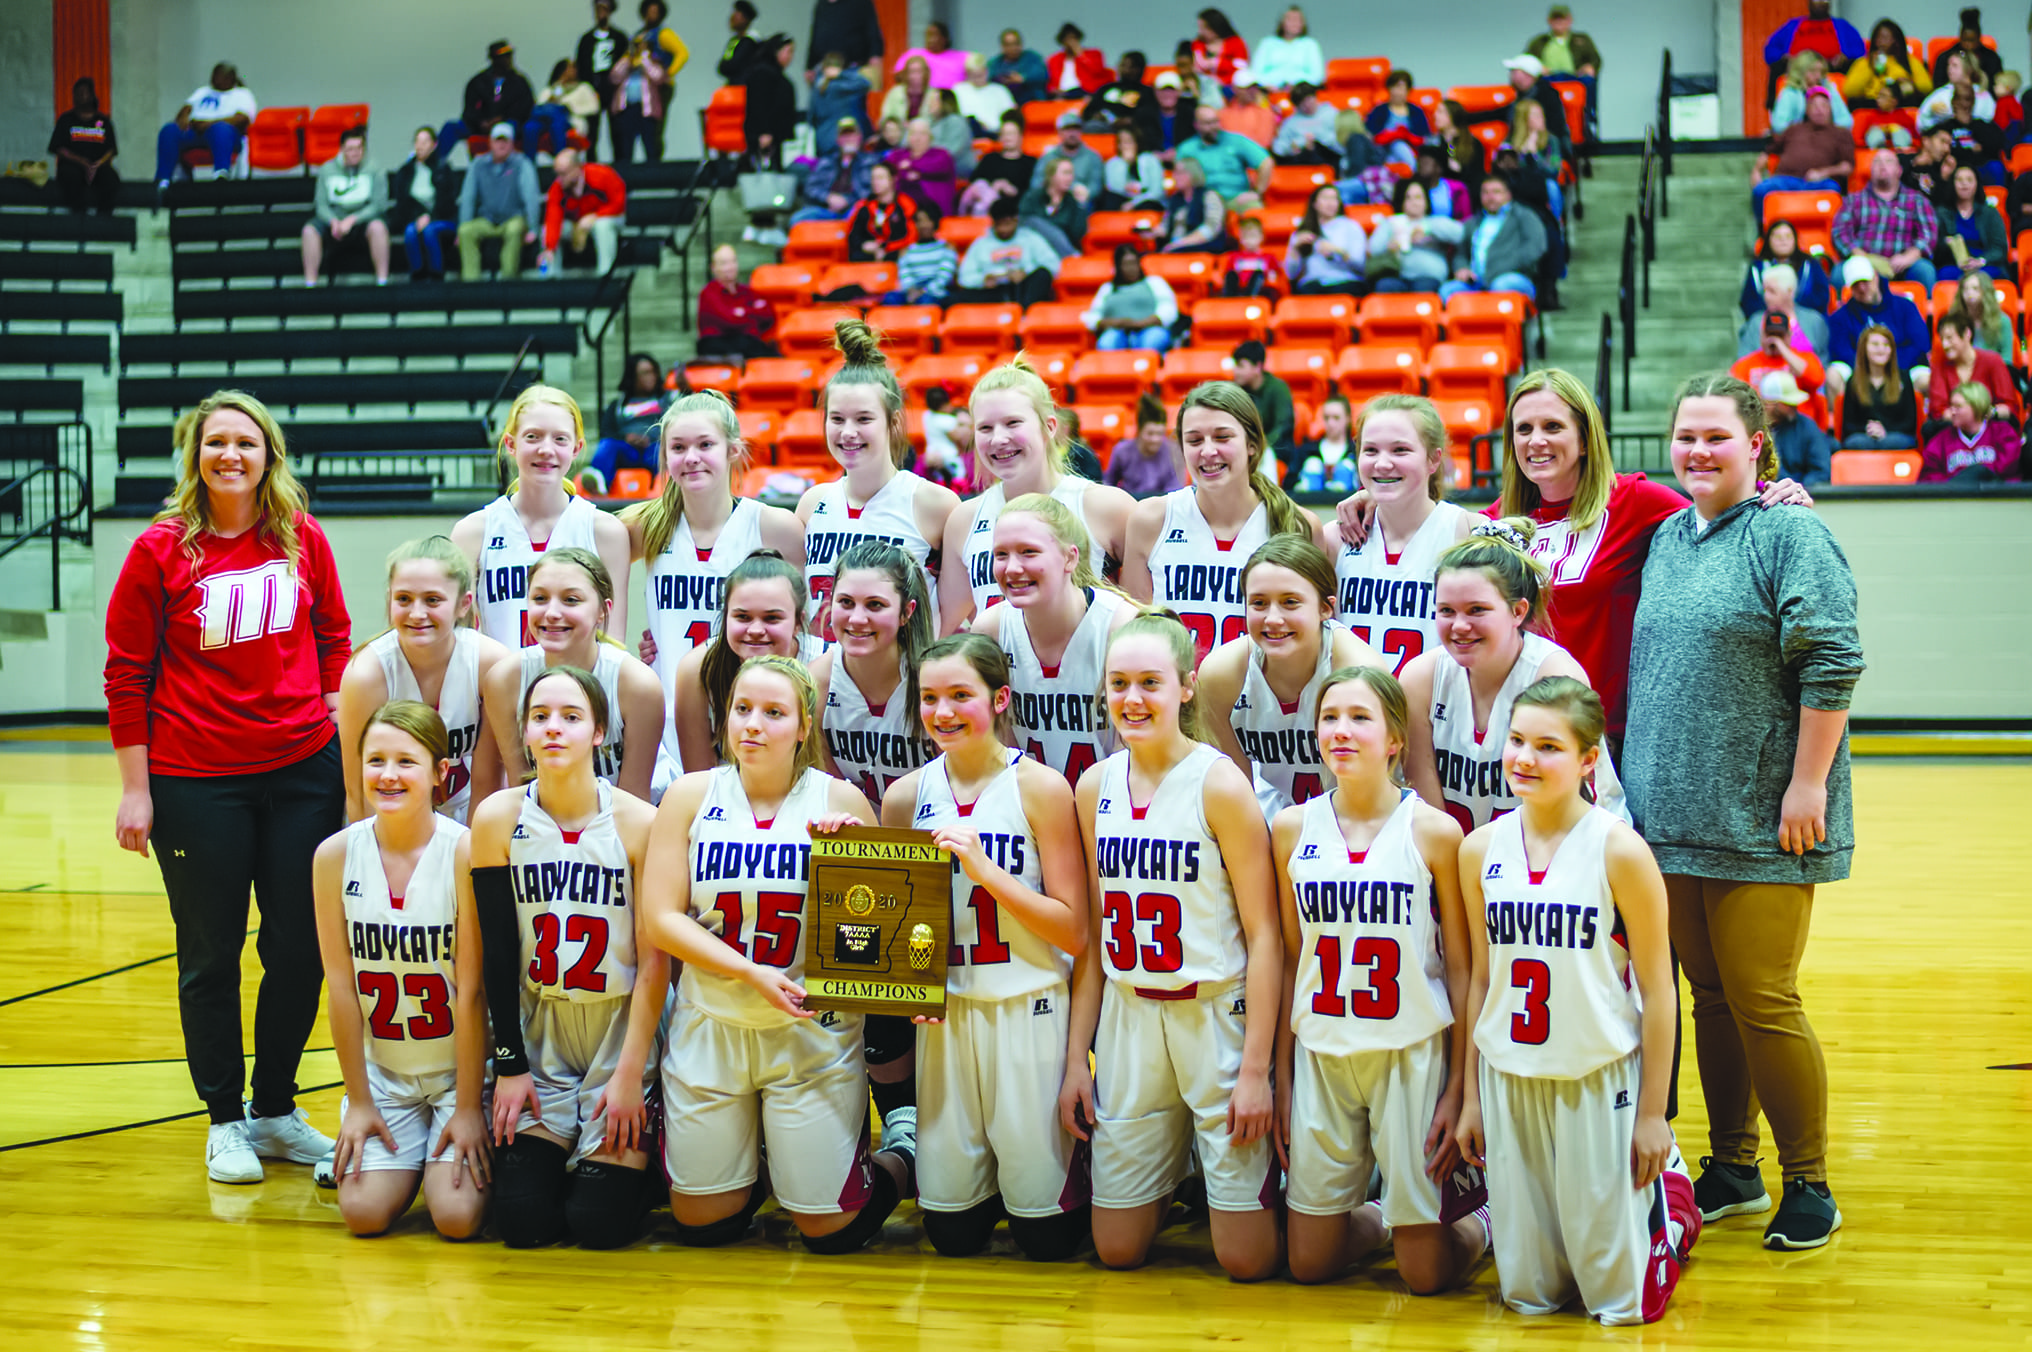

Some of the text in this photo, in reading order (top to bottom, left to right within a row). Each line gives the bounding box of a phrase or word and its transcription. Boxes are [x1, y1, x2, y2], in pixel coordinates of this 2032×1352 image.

[193, 558, 300, 651] M
[696, 841, 812, 882] LADYCAT
[820, 841, 941, 861] TOURNAMENT
[512, 860, 626, 907] LADYCATS
[349, 920, 454, 964] ADYCATS
[528, 911, 609, 993] 32
[712, 891, 806, 969] 15
[839, 924, 877, 933] DISTRICT
[1103, 890, 1184, 974] 33
[1486, 901, 1599, 950] ADYCATS
[357, 970, 454, 1041] 23
[823, 980, 928, 1001] CHAMPIONS
[1311, 934, 1401, 1020] 13
[1510, 957, 1551, 1045] 3
